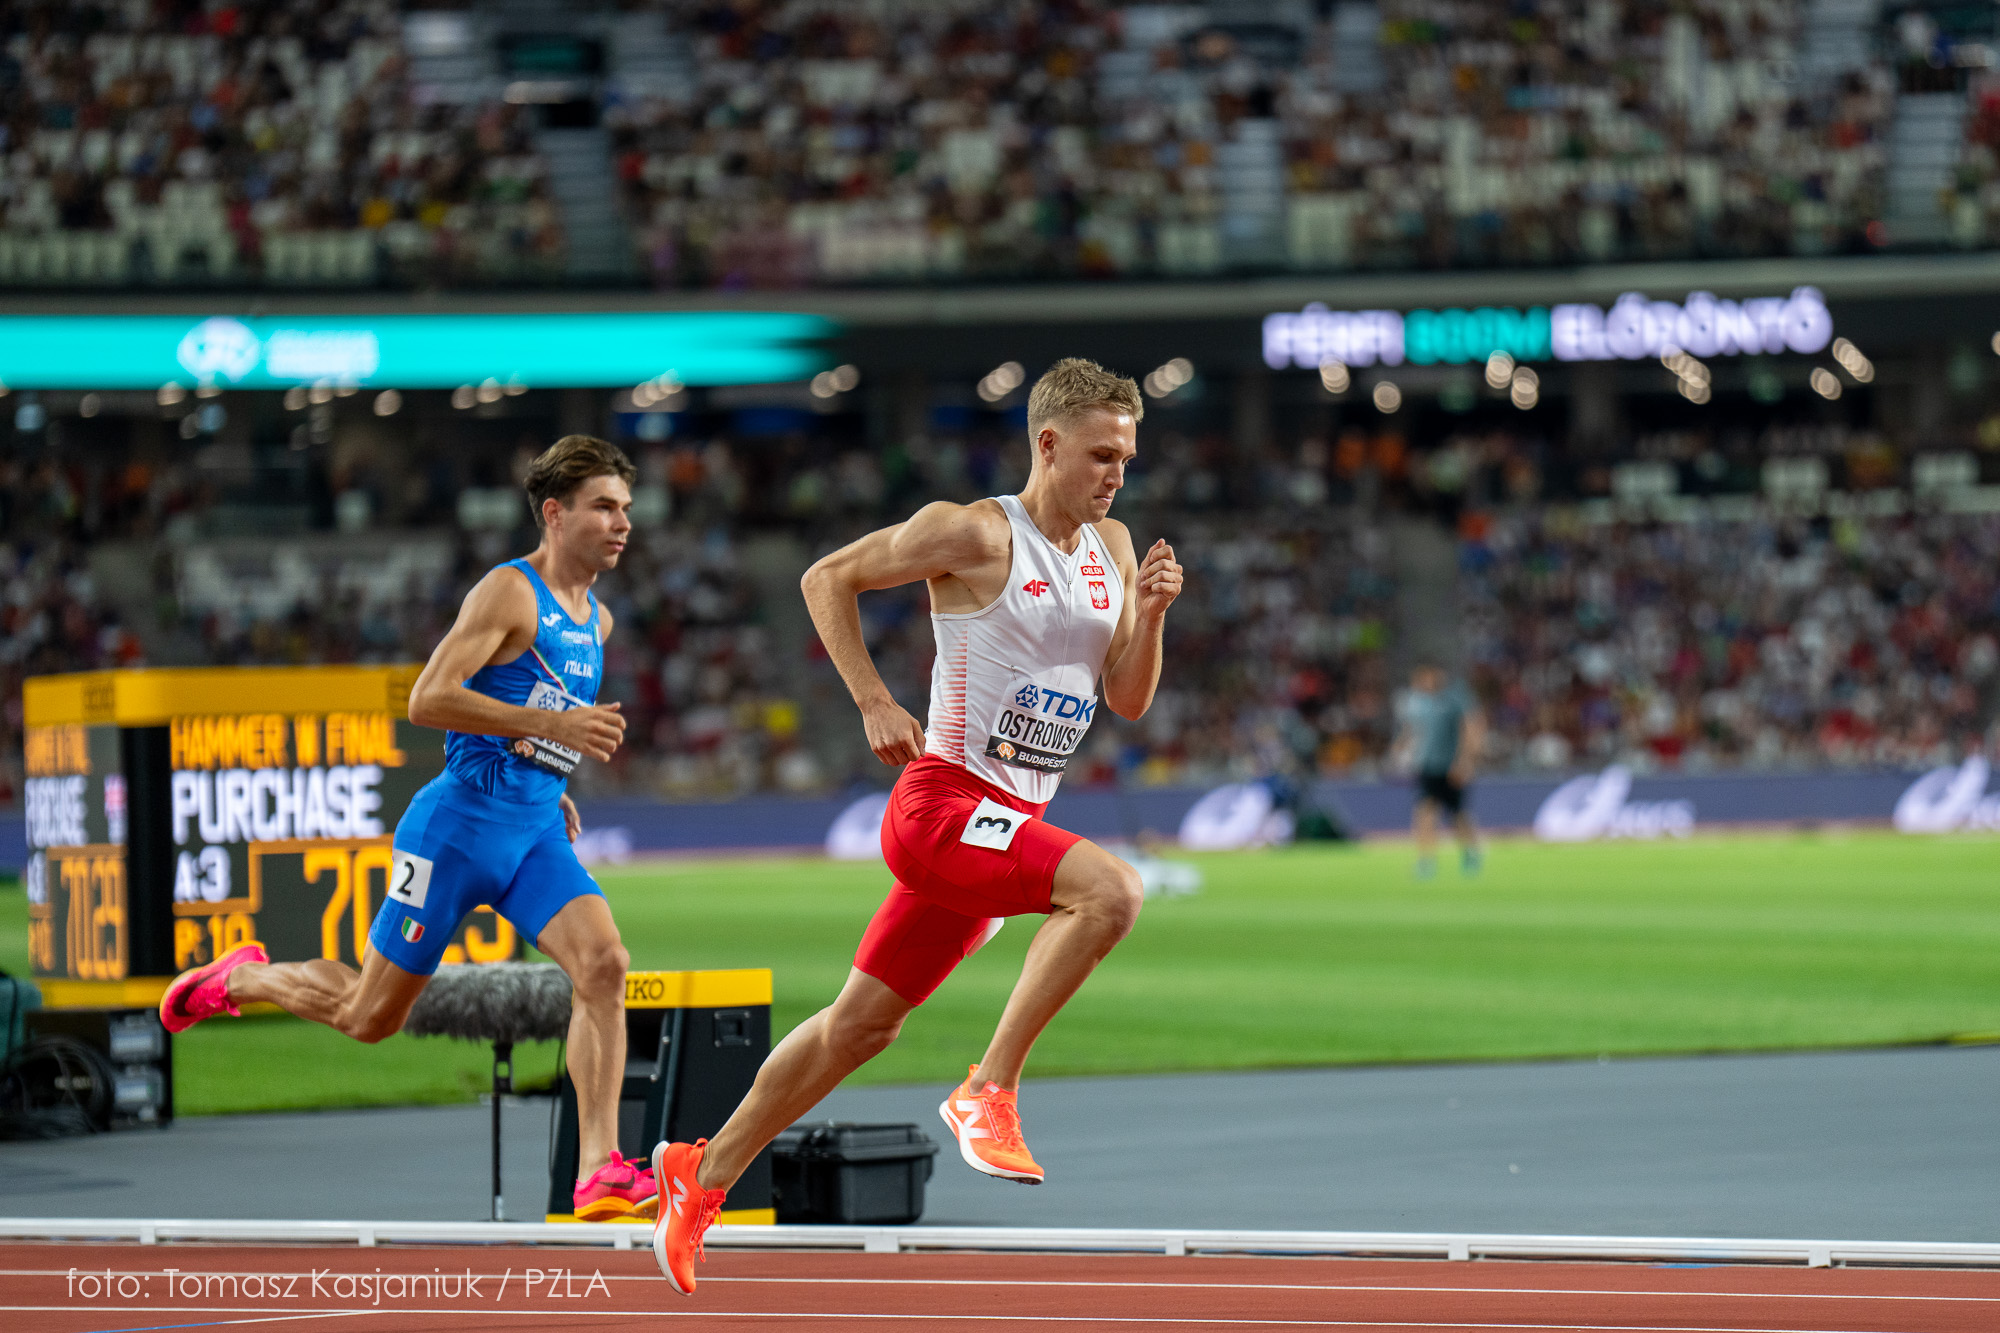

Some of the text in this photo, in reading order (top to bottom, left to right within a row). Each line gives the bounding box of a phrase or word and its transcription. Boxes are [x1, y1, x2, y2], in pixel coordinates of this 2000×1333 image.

[1022, 579, 1050, 597] 4F
[564, 660, 593, 679] ITALIA
[1041, 688, 1097, 722] TDK
[170, 714, 288, 771] HAMMER
[325, 712, 408, 768] FINAL
[535, 750, 575, 774] BUDAPEST
[172, 764, 385, 846] PURCHASE
[974, 816, 1012, 834] 3
[397, 861, 415, 897] 2
